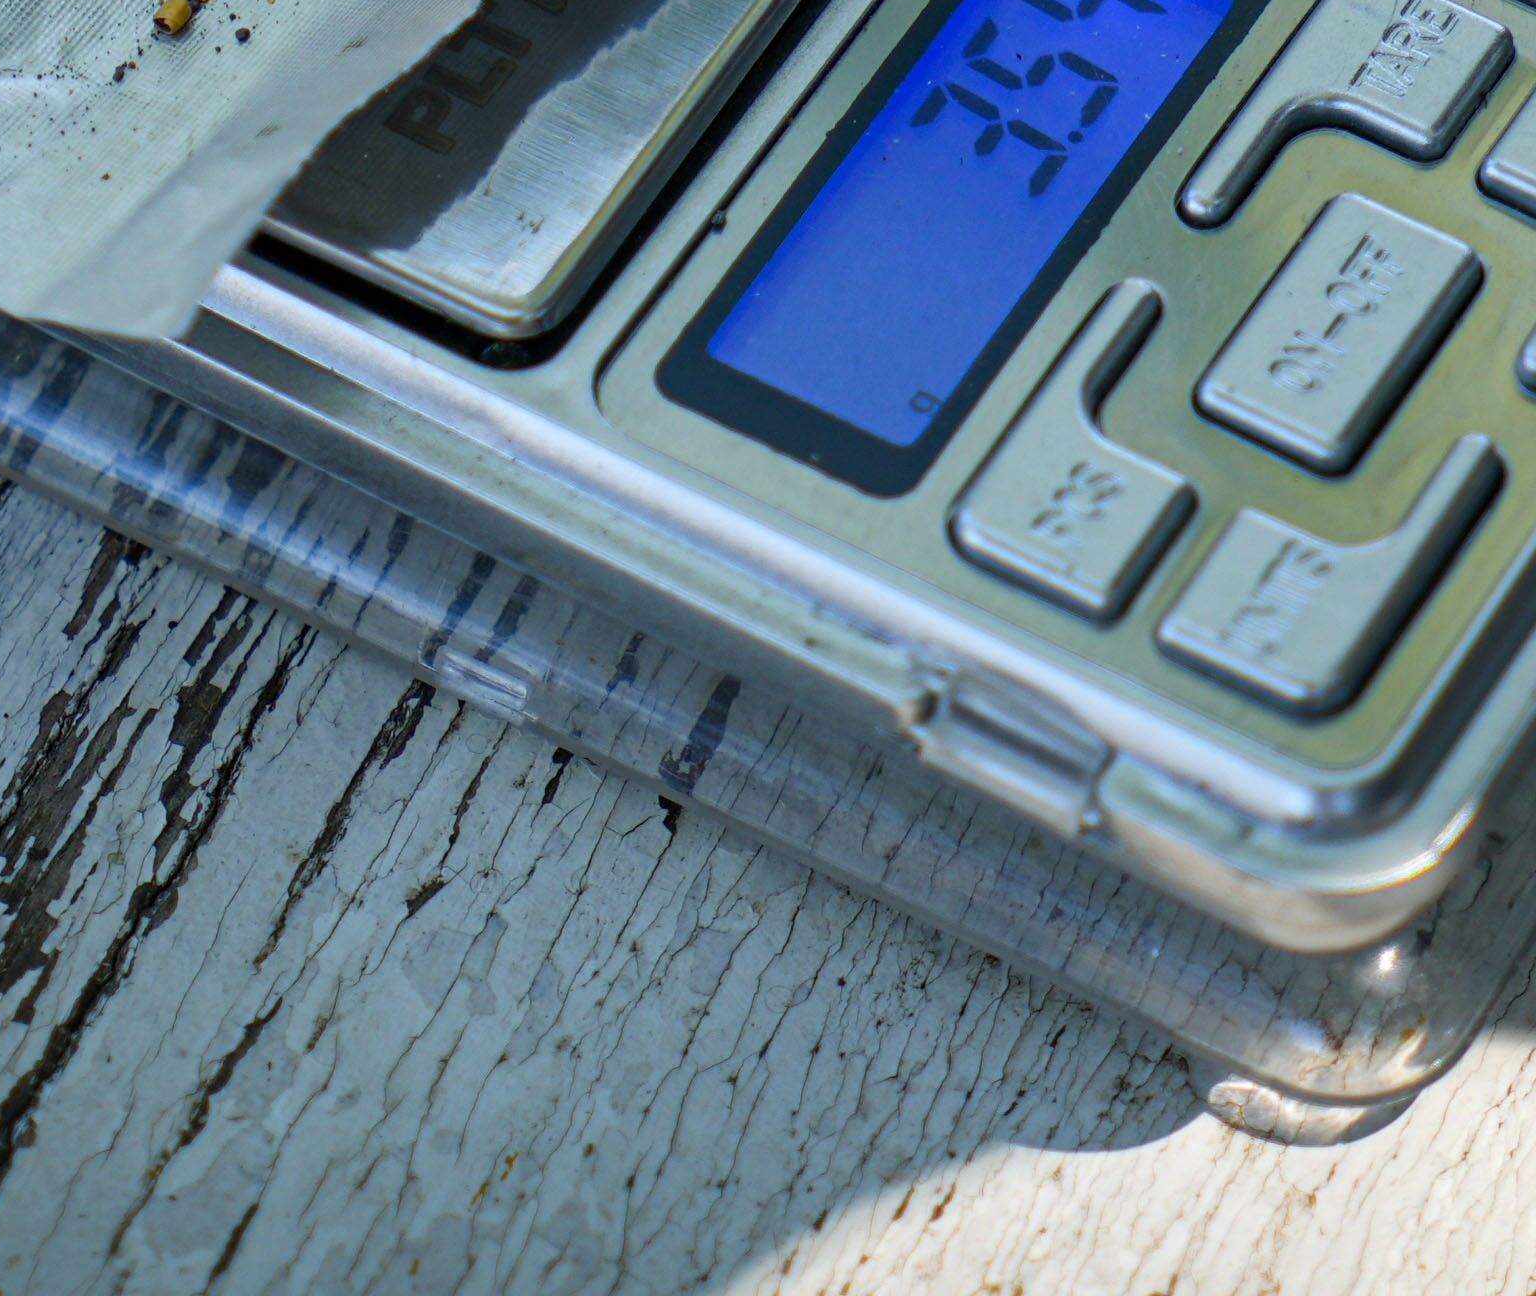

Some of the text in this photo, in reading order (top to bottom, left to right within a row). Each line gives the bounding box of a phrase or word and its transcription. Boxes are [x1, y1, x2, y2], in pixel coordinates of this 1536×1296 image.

[1266, 232, 1410, 396] ON-OFF
[1032, 460, 1127, 550] PCS
[1216, 538, 1336, 659] UNITS
